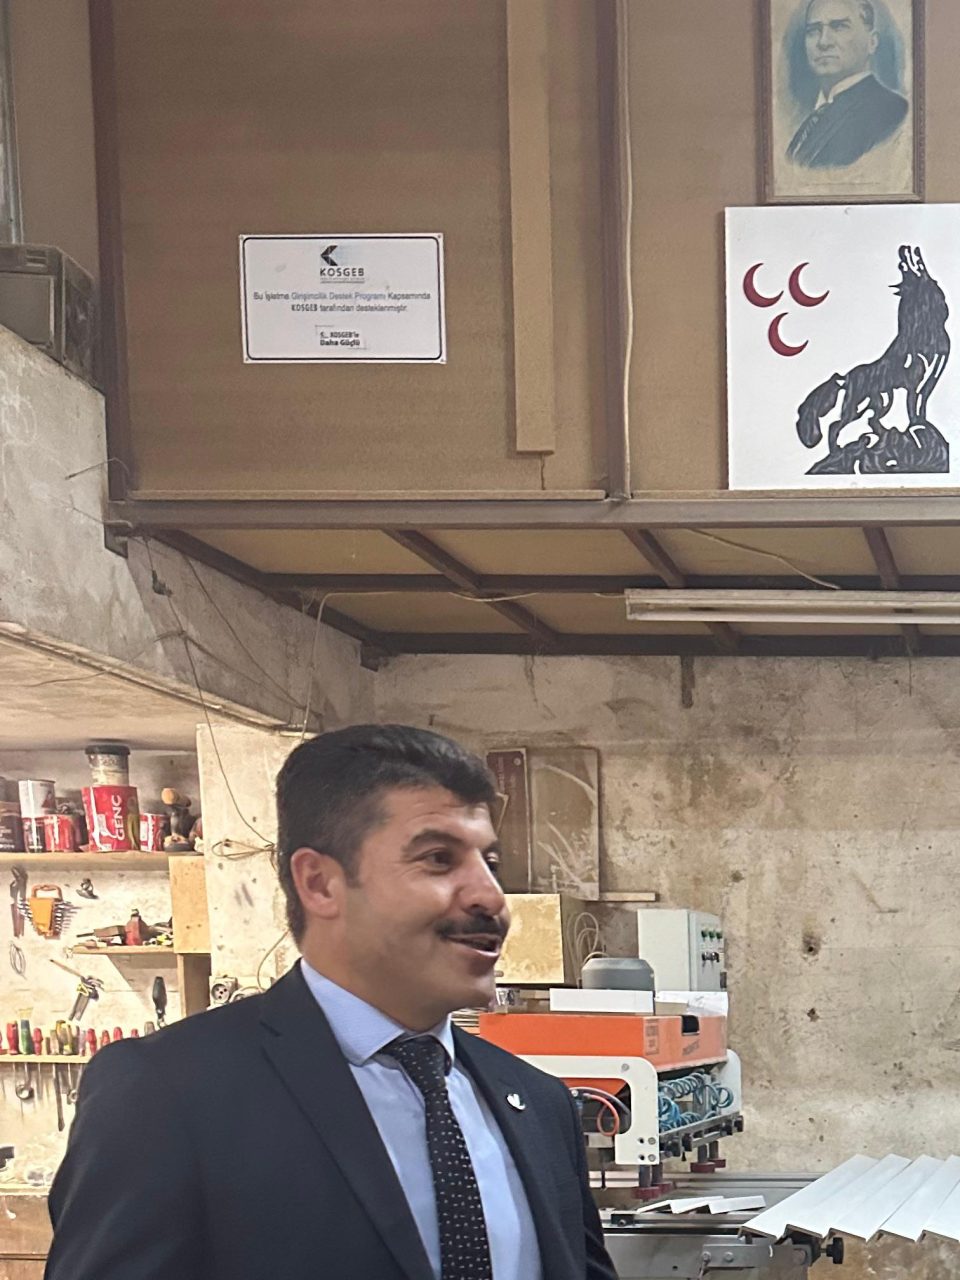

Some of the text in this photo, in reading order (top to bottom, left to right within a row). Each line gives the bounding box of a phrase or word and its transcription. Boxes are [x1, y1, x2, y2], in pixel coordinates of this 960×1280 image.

[320, 267, 365, 277] KOSGEB
[253, 291, 264, 300] Bu
[291, 303, 318, 312] KOSGEB
[320, 339, 339, 347] Daha
